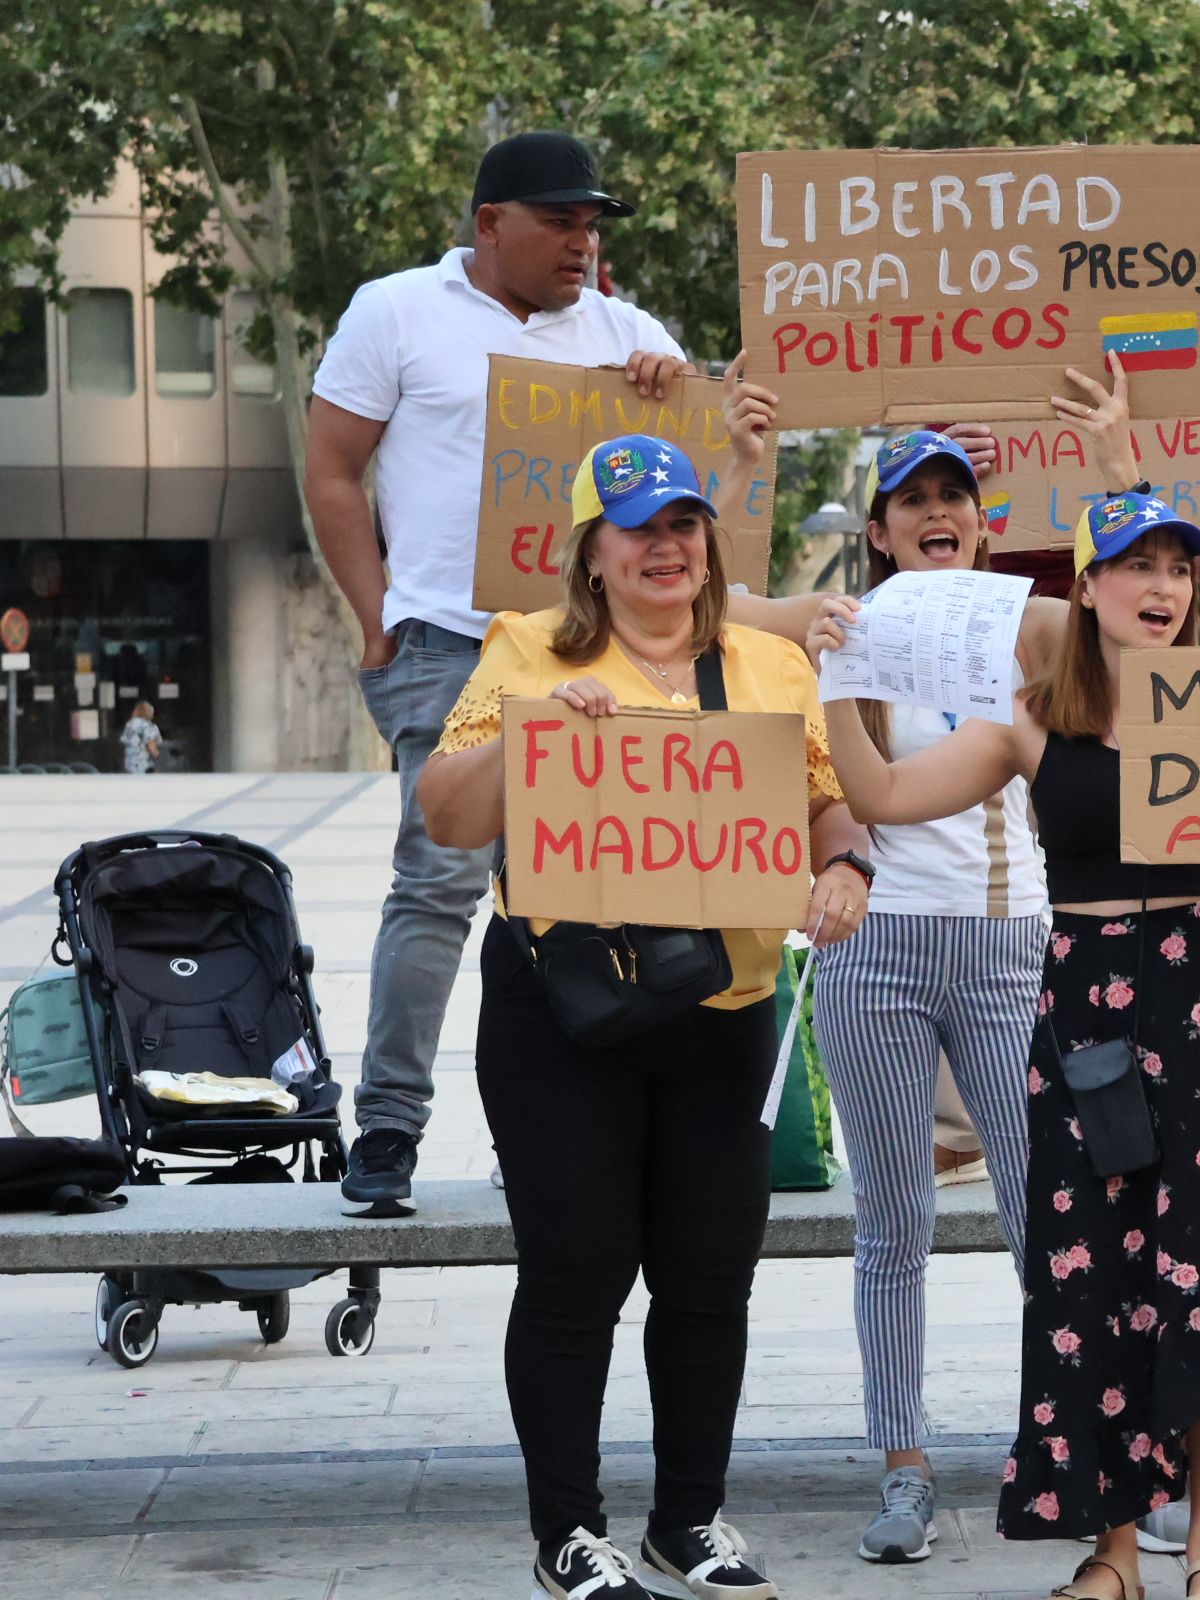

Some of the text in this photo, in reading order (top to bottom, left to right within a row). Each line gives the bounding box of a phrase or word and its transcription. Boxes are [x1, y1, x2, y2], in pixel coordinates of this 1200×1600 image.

[760, 171, 1121, 250] LIBERTAD
[763, 245, 909, 315] PARA
[938, 245, 1039, 296] LOS
[498, 378, 733, 450] EDMUND
[512, 523, 560, 576] EL
[523, 719, 744, 794] FUERA
[533, 815, 802, 876] MADURO
